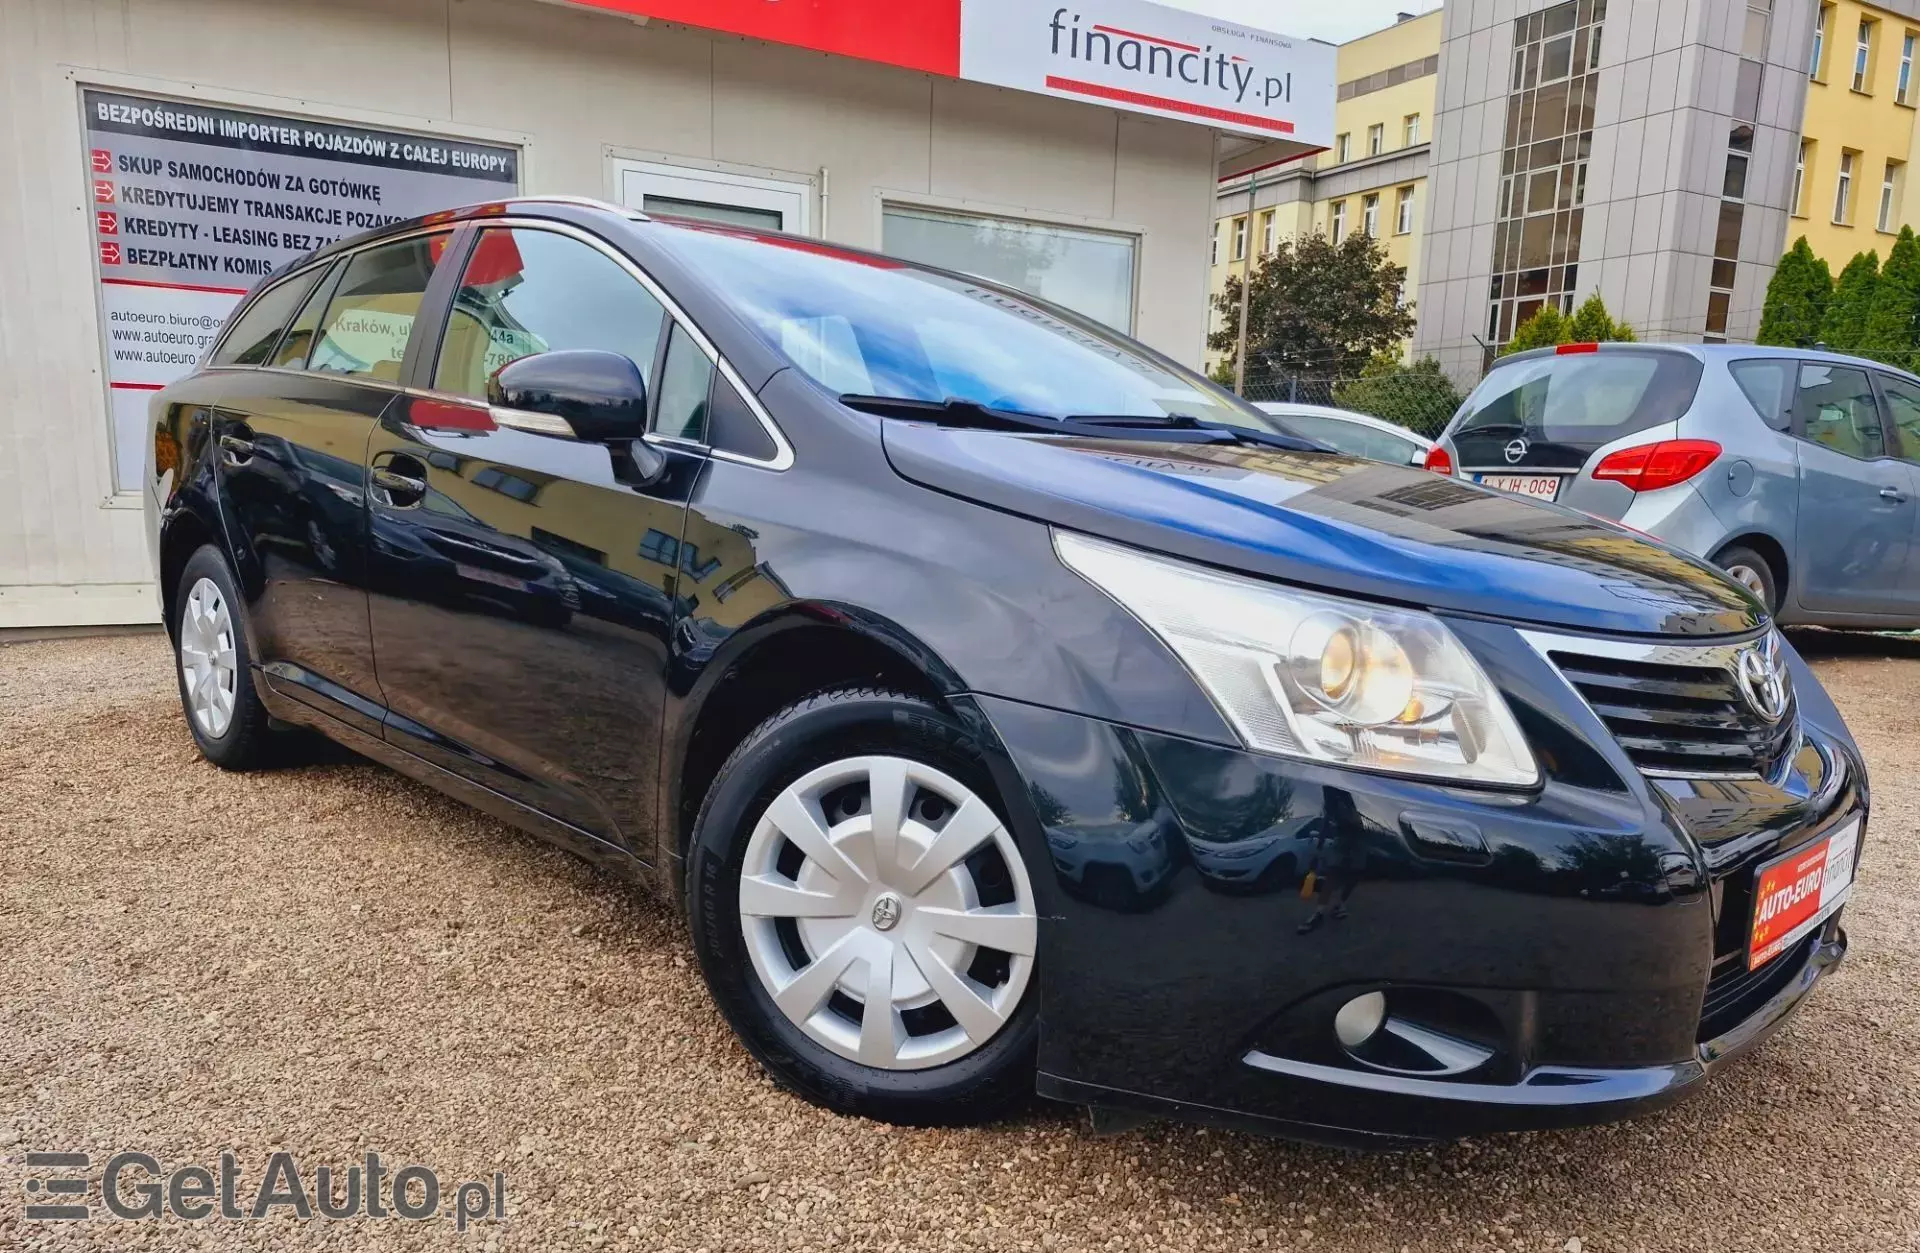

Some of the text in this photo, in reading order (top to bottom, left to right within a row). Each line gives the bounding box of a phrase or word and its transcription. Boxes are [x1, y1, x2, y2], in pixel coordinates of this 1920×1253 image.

[1049, 8, 1291, 106] financity.pl
[97, 102, 507, 173] BEZPOŚREDNI IMPORTER POJAZDÓW Z CAŁEJ EUROPY
[118, 154, 382, 206] SKUP SAMOCHODÓW ZA GOTÓWKĘ
[121, 186, 408, 229] KREDYTUJEMY TRANSAKCJE POZAK
[124, 217, 199, 241] KREDYTY
[213, 226, 278, 249] LEASING
[283, 233, 312, 251] BEZ
[127, 248, 273, 276] BEZPŁATNY KOMIS
[335, 317, 395, 337] Kraków,
[114, 350, 202, 365] www.autoeuro
[1758, 866, 1822, 925] AUTO-EURO
